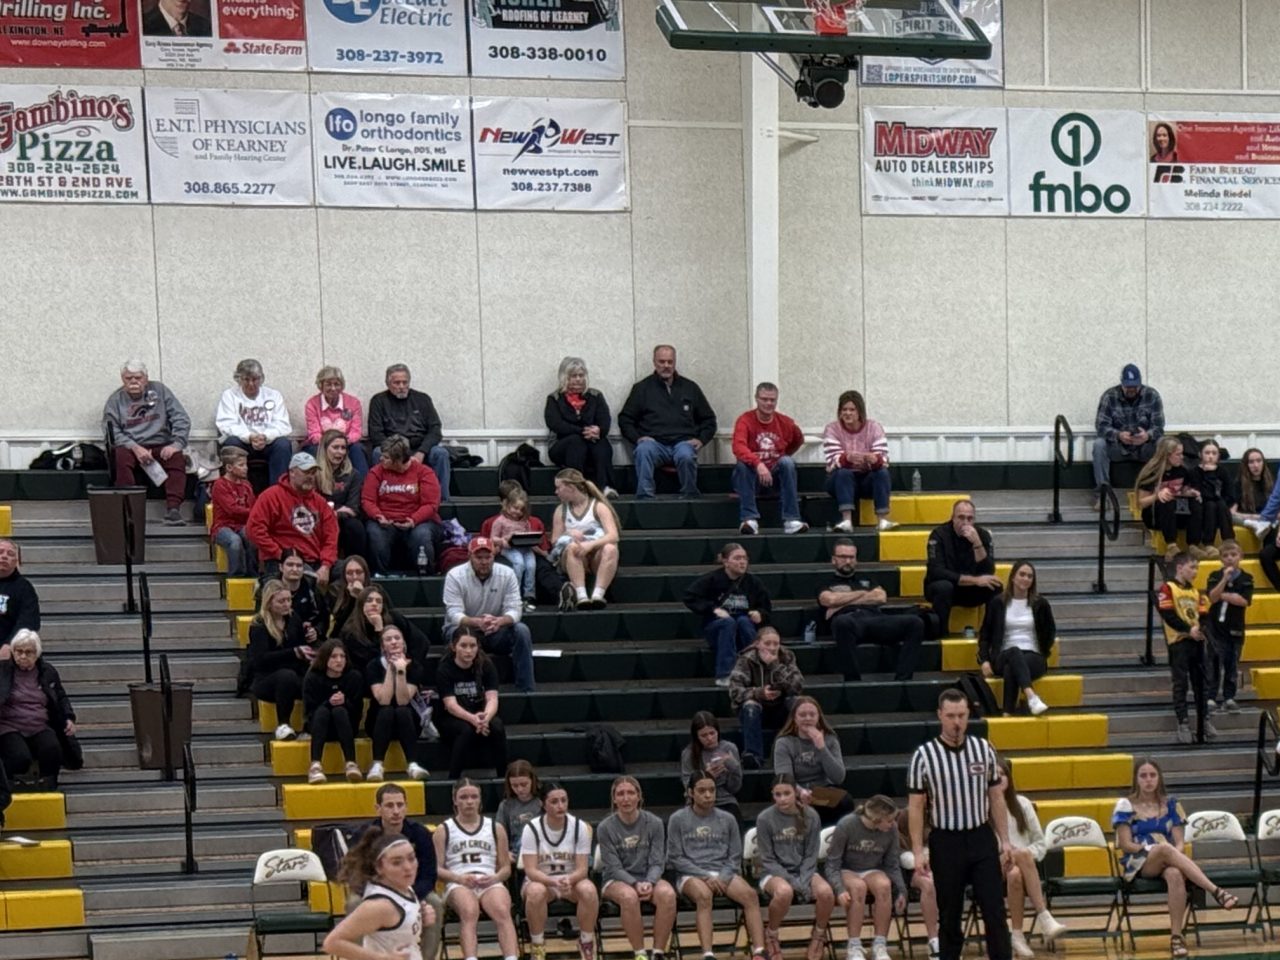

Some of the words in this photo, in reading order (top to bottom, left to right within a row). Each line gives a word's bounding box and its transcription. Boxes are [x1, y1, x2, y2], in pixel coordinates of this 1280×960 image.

[0, 0, 67, 21] rilling
[73, 1, 111, 19] Inc.
[222, 5, 299, 19] everything.
[379, 7, 453, 27] Electric
[502, 9, 538, 22] ROOFING
[541, 10, 550, 22] OF
[552, 11, 589, 24] KEARNEY
[895, 19, 932, 34] SPIRIT
[937, 20, 962, 33] SHO
[336, 48, 444, 64] 308-237-3972
[488, 45, 607, 62] 308-338-0010
[0, 90, 134, 152] Gambino's
[359, 110, 405, 127] longo
[411, 111, 459, 129] family
[204, 120, 306, 135] PHYSICIANS
[361, 126, 462, 141] orthodontics
[16, 131, 117, 162] Pizza
[192, 138, 212, 150] OF
[216, 140, 288, 152] KEARNEY
[874, 121, 998, 159] MIDWAY
[8, 162, 120, 175] 308-224-2624
[324, 155, 467, 173] LIVE.LAUGH.SMILE
[875, 160, 907, 173] AUTO
[911, 160, 994, 174] DEALERSHIPS
[502, 167, 599, 178] newwestpt.com
[37, 176, 54, 188] ST
[71, 177, 101, 189] 2ND
[105, 177, 133, 189] AVE
[183, 181, 275, 195] 308.865.2277
[511, 182, 592, 193] 308.237.7388
[1028, 170, 1132, 214] fnbo
